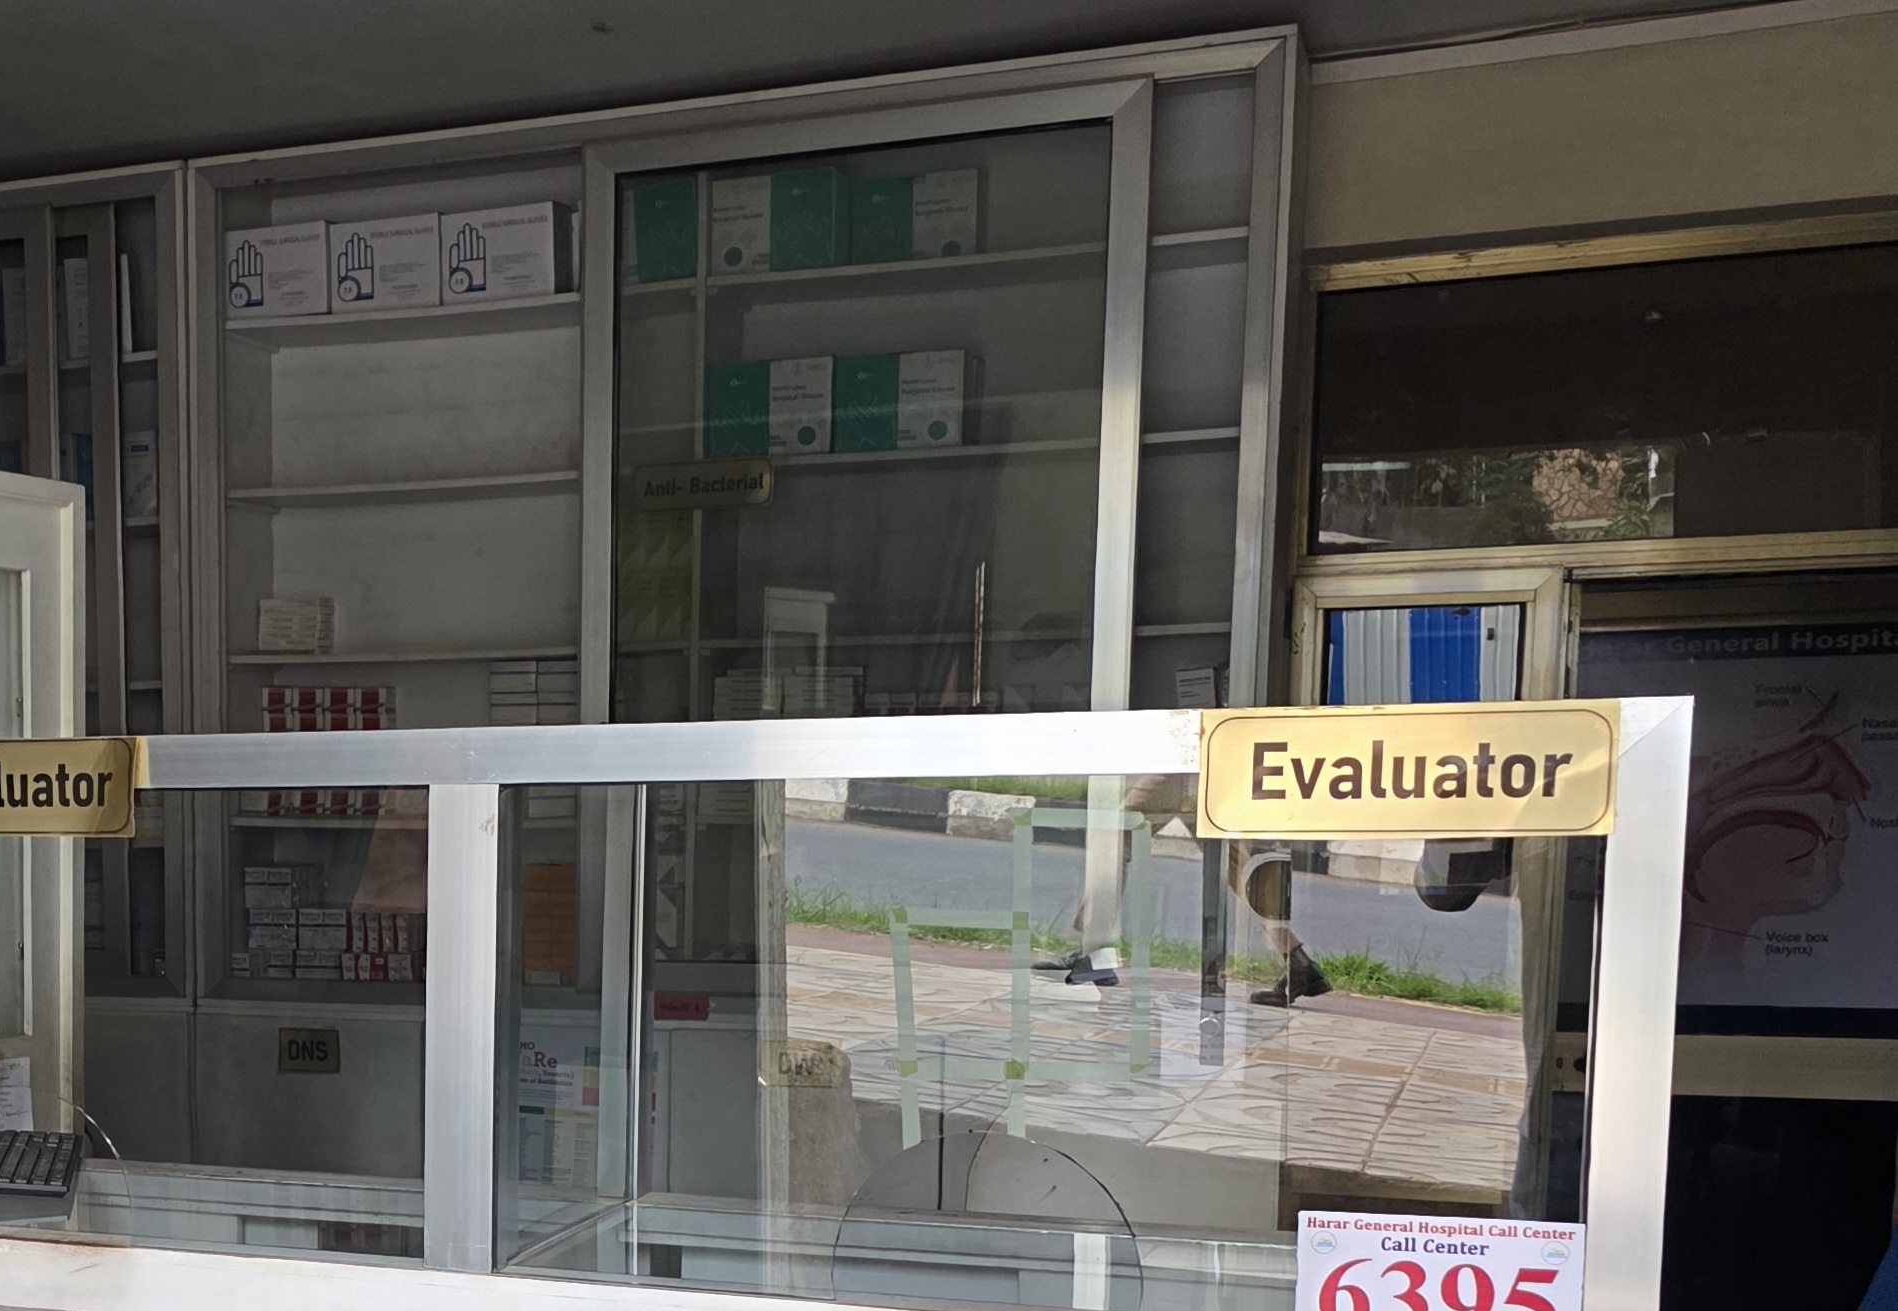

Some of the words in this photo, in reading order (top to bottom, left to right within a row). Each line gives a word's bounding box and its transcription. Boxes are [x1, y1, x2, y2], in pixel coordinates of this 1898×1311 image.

[643, 478, 685, 498] Anti-
[689, 472, 765, 495] Bacterial
[1666, 631, 1780, 657] General
[1250, 739, 1574, 802] Evaluator
[1765, 930, 1805, 943] Voice
[1806, 930, 1830, 943] box
[287, 1038, 329, 1062] DNS
[1306, 1216, 1351, 1232] Harar
[1353, 1218, 1414, 1234] General
[1417, 1222, 1485, 1239] Hospital
[1488, 1225, 1519, 1239] Call
[1522, 1226, 1577, 1242] Center
[1380, 1237, 1417, 1254] Call
[1422, 1238, 1490, 1257] Center
